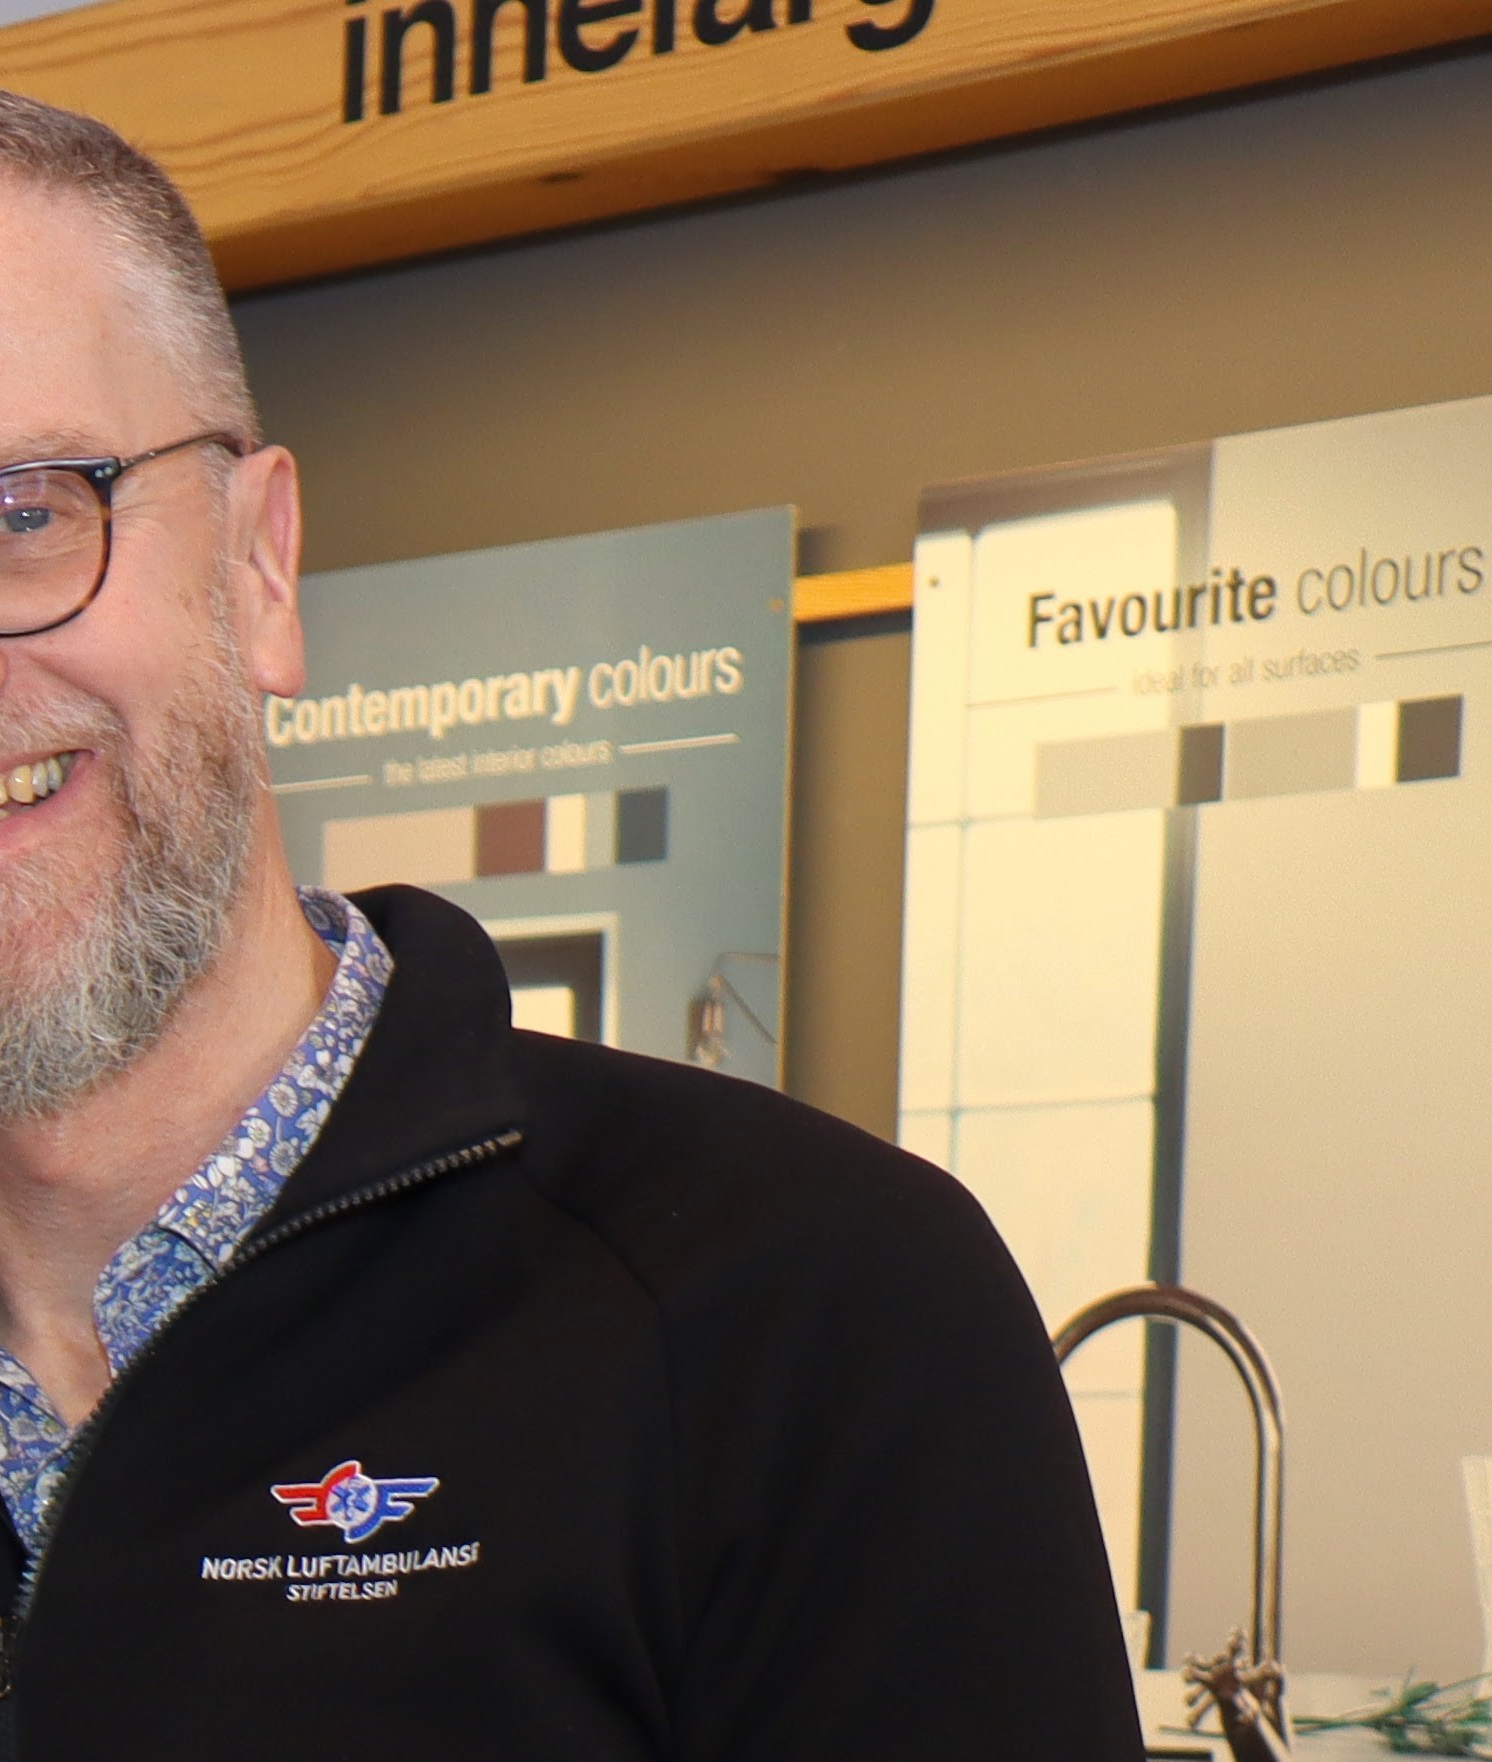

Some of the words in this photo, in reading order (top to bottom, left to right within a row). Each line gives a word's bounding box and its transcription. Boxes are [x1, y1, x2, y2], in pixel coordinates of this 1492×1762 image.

[1026, 565, 1278, 650] Favourite
[1295, 545, 1485, 617] colours
[264, 665, 582, 747] Contemporary
[587, 644, 746, 710] colours
[201, 1555, 282, 1581] NORSK
[285, 1579, 399, 1602] STIFTELSEN
